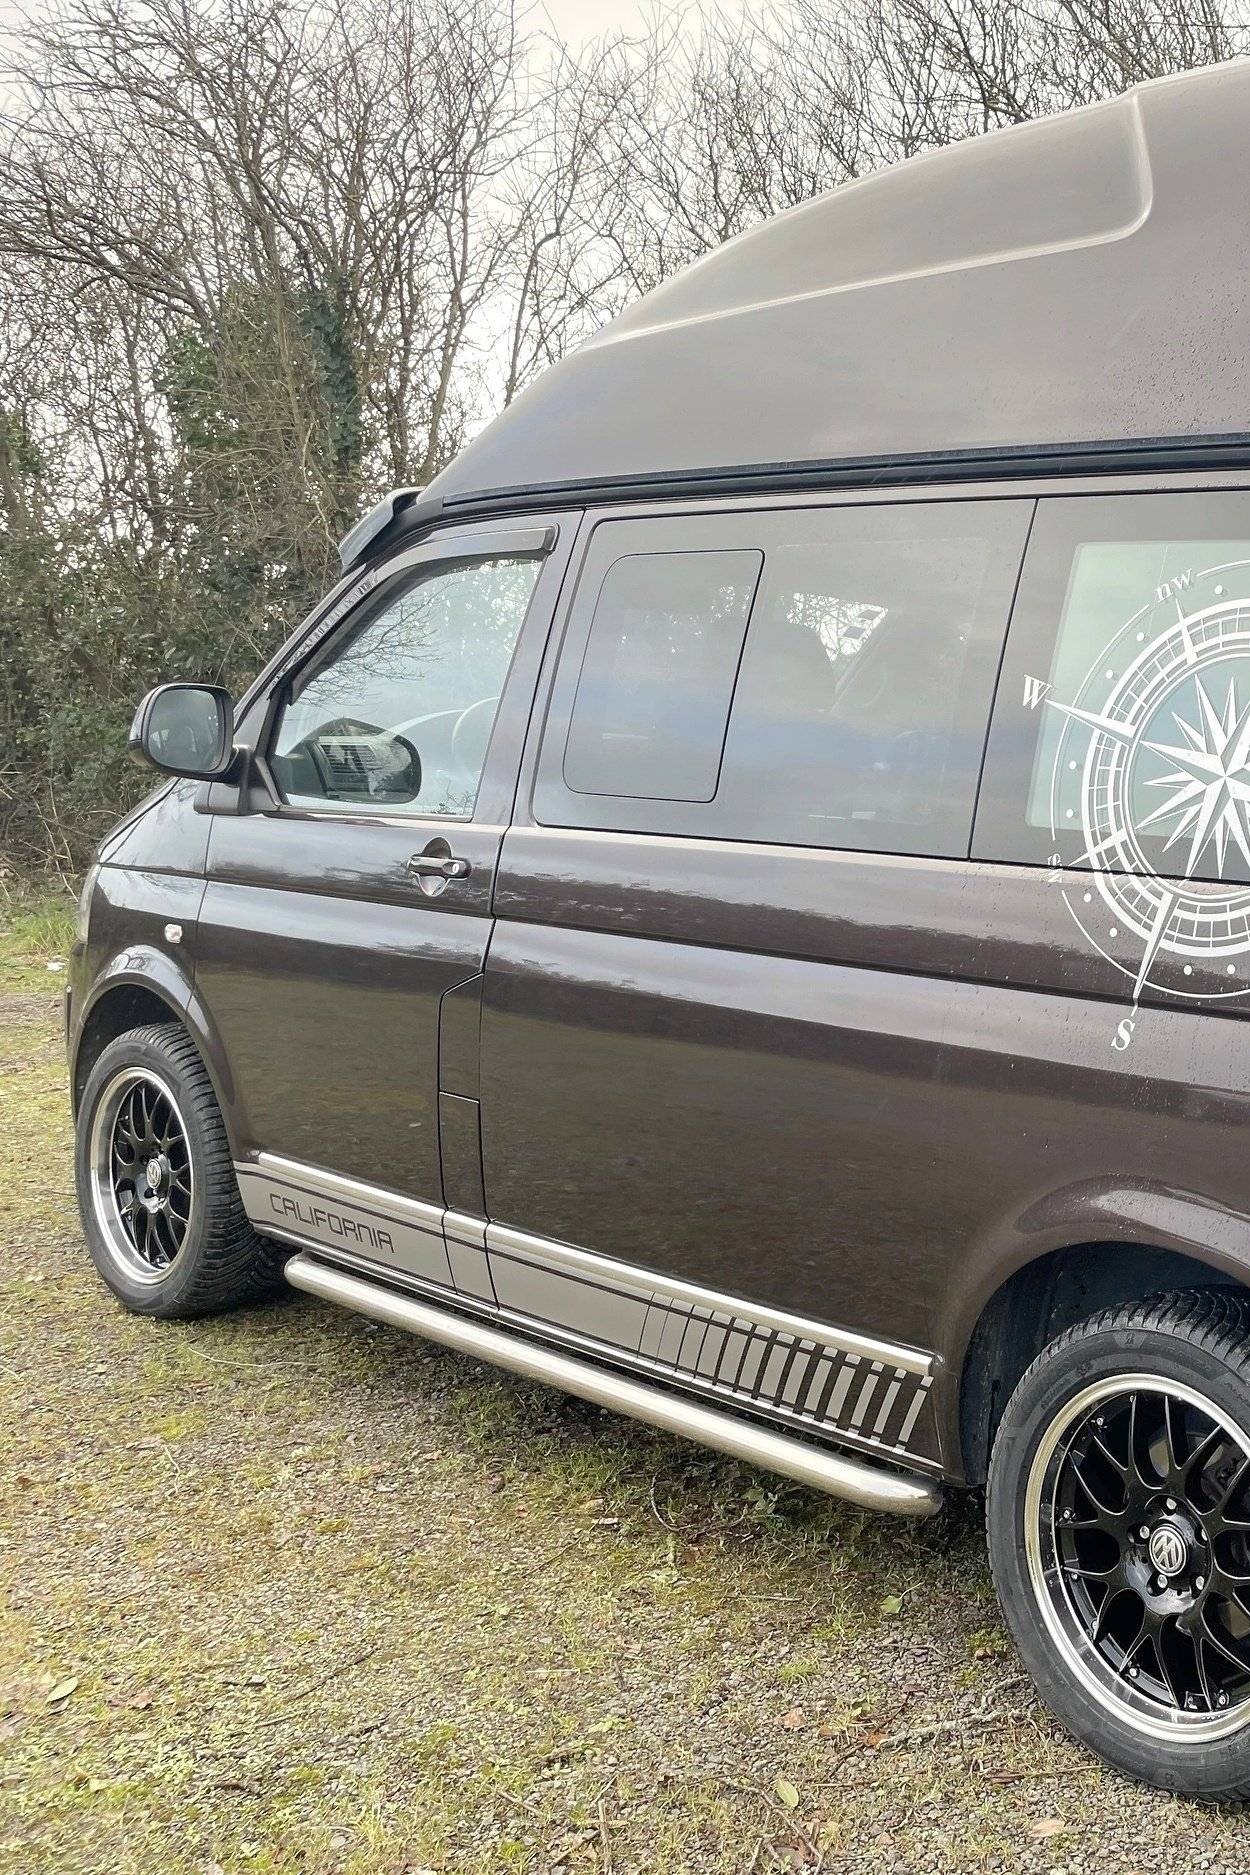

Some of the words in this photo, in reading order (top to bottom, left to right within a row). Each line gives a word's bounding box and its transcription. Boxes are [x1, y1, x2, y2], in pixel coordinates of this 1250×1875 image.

[1155, 568, 1192, 603] nw
[1022, 674, 1053, 710] W
[1110, 1018, 1136, 1051] S
[269, 1193, 395, 1254] CALIFORNIA
